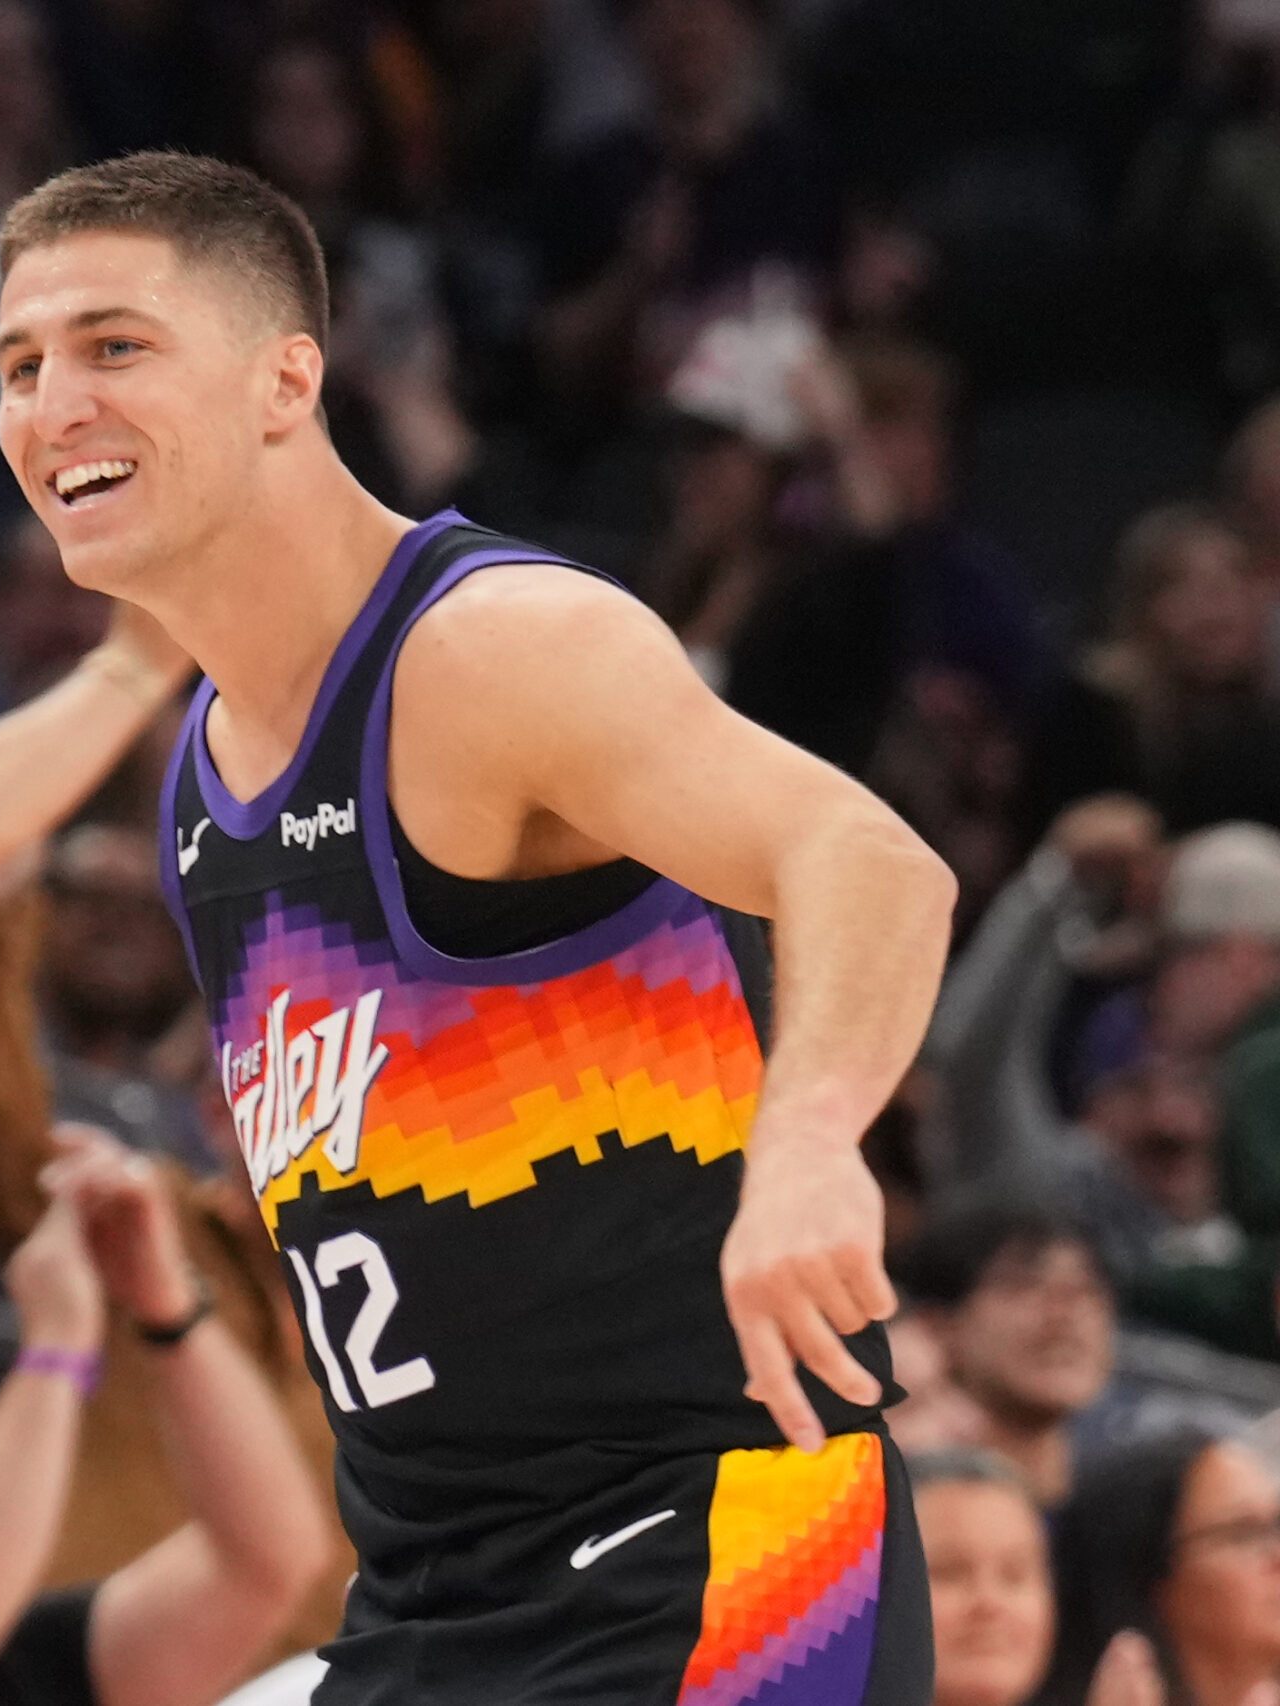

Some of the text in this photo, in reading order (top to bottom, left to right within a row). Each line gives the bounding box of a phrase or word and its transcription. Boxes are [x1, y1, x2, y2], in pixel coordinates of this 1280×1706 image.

[280, 797, 357, 852] PayPal
[231, 1039, 264, 1092] THE
[284, 1229, 437, 1414] 12
